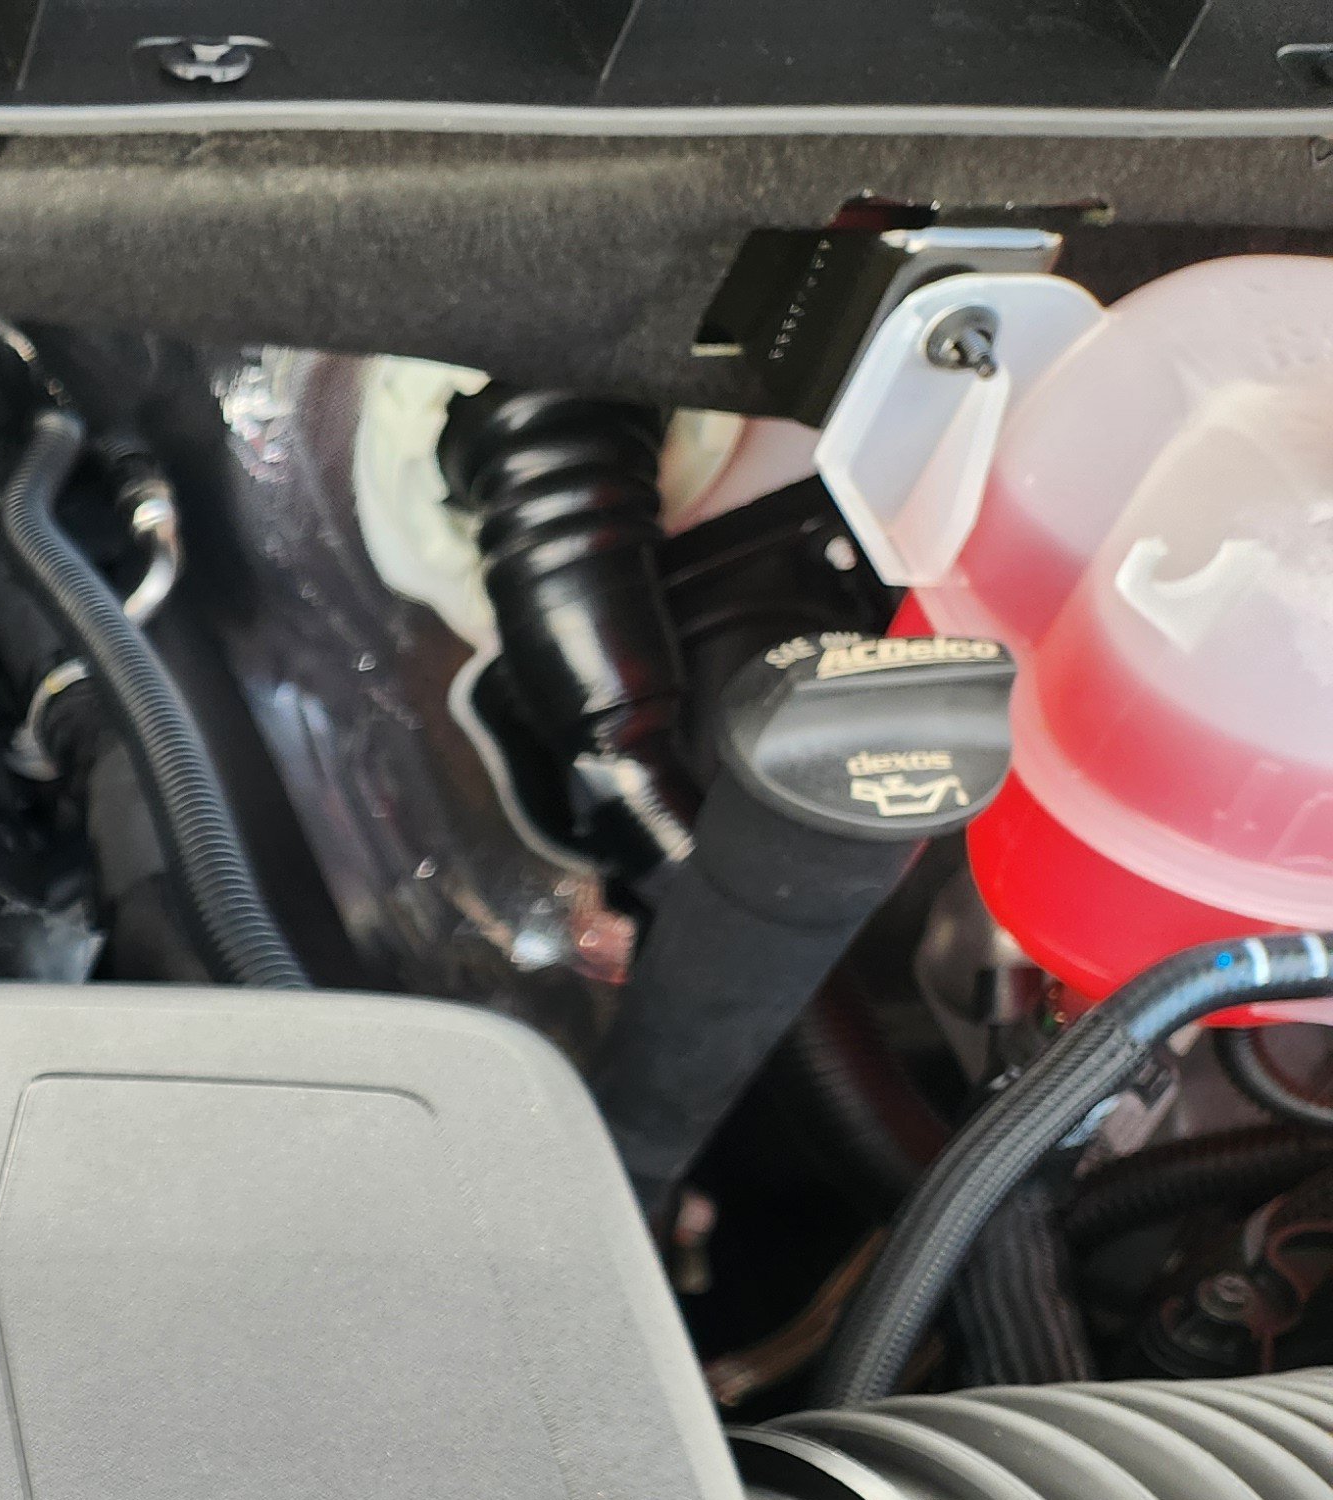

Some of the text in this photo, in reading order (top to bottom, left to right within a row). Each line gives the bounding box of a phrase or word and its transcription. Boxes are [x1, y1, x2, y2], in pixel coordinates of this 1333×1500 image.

[765, 636, 818, 669] SAE
[817, 637, 1000, 676] ACDelco
[845, 750, 952, 776] dexos
